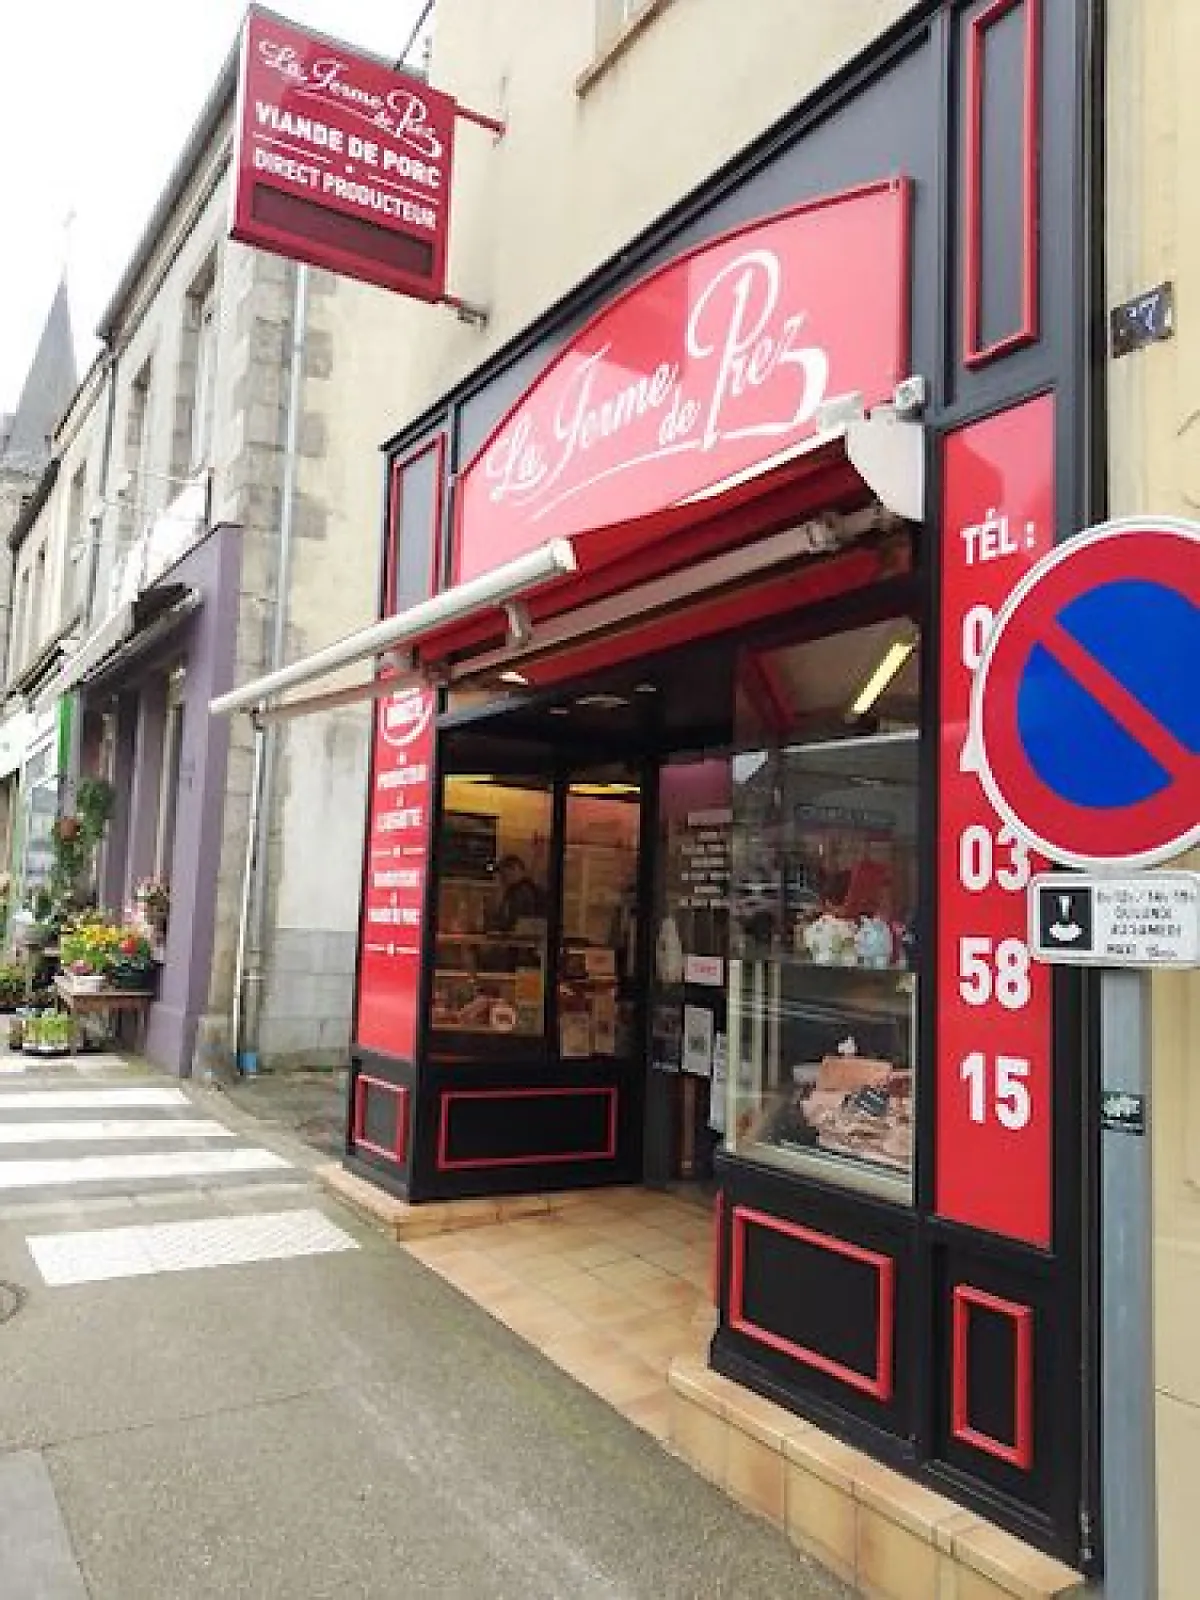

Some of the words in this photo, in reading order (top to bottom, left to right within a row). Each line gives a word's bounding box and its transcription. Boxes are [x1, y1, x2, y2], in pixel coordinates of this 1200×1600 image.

[255, 101, 344, 153] VIANDE
[347, 136, 379, 166] DE
[384, 149, 442, 188] PORC
[253, 147, 320, 188] DIRECT
[322, 172, 437, 230] PRODUCTEUR
[958, 824, 1030, 891] 03
[958, 936, 1030, 1010] 58
[959, 1051, 1031, 1131] 15
